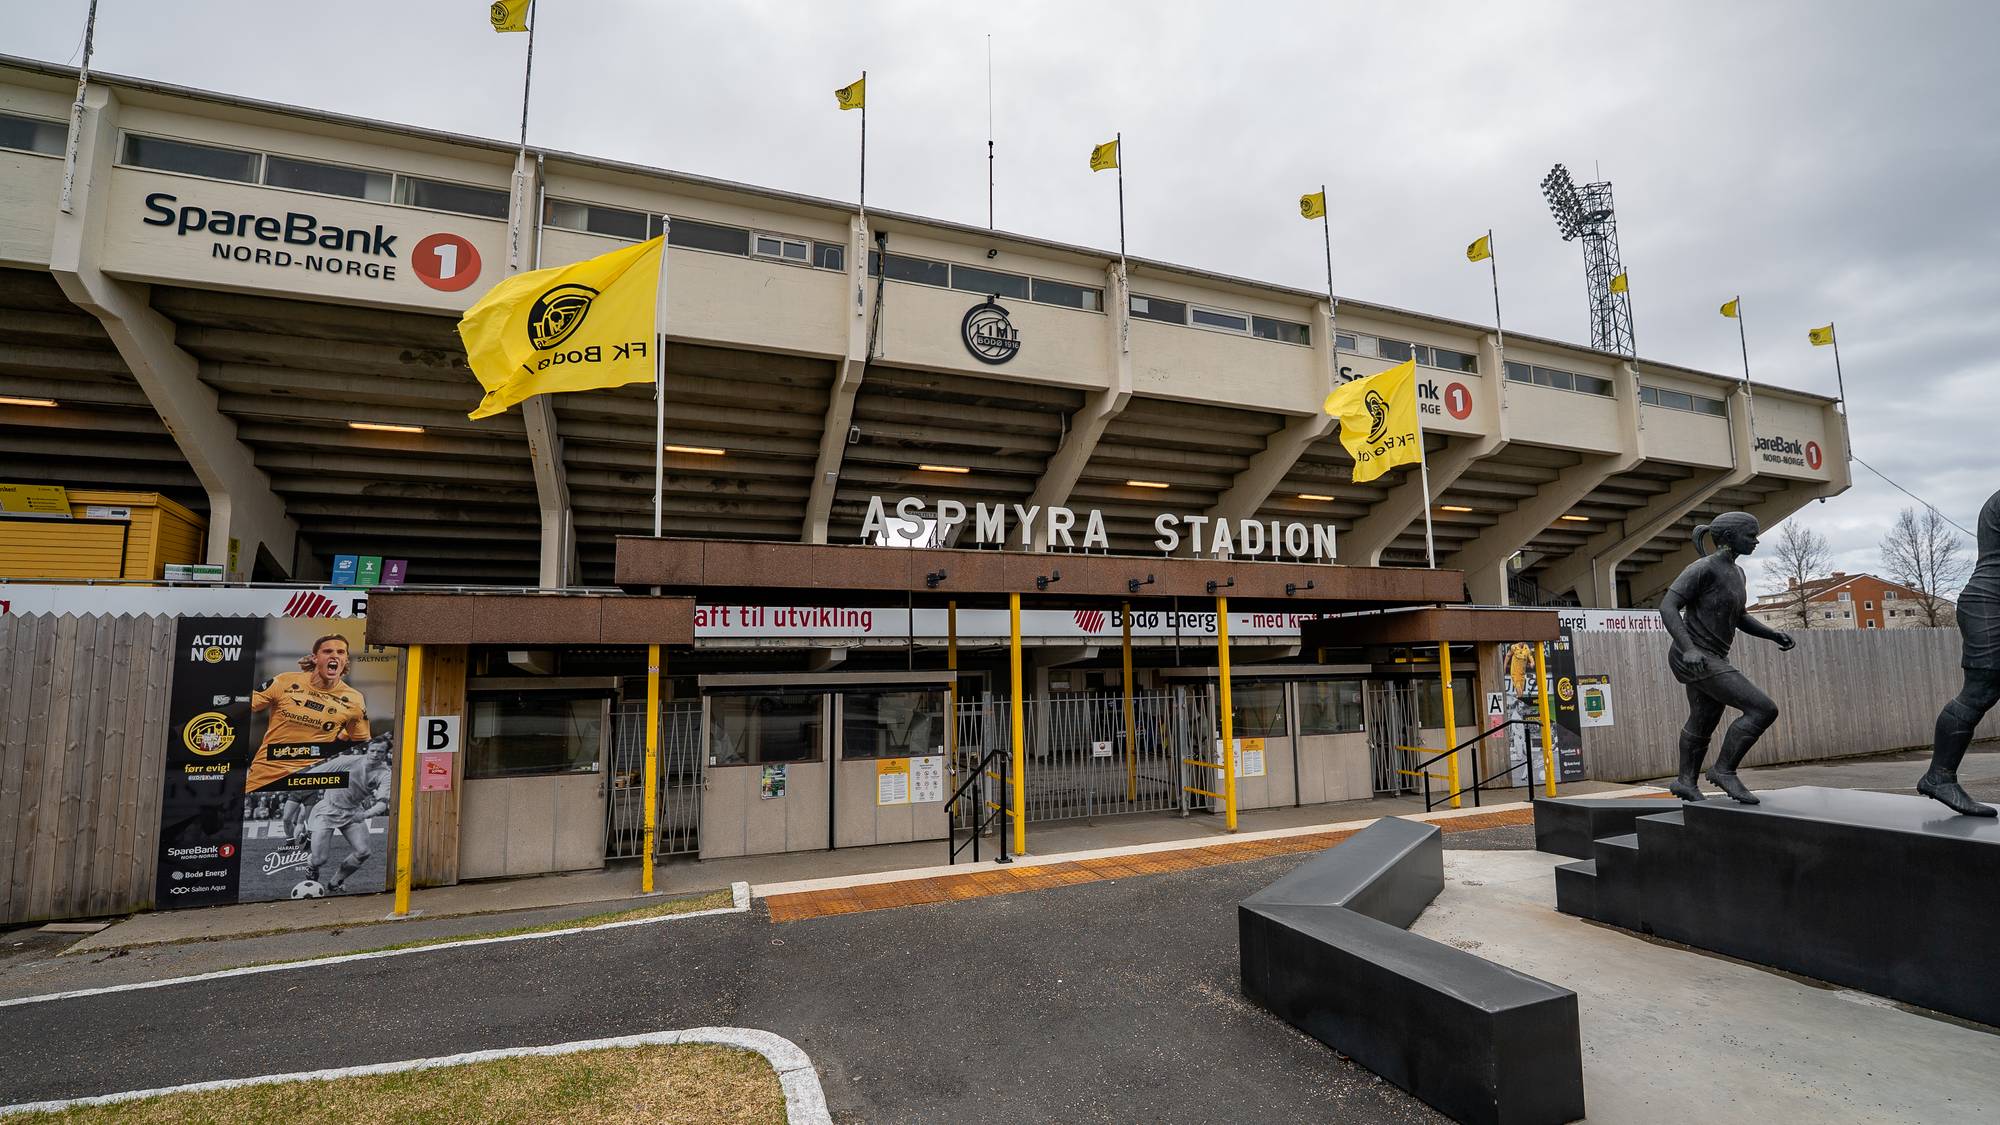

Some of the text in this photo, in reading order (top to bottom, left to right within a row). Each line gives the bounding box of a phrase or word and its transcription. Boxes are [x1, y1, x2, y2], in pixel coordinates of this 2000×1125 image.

[143, 192, 398, 258] SpareBank
[211, 242, 396, 281] NORD-NORGE
[977, 337, 1002, 346] BODØ
[1754, 436, 1803, 455] pareBank
[1762, 453, 1805, 467] NORD-NORGE
[859, 495, 1337, 559] ASPMYRA STADION
[694, 606, 872, 632] aft til utvikling
[1166, 611, 1217, 633] Energ
[1559, 614, 1587, 632] nergi
[1628, 615, 1651, 629] kraft
[192, 634, 243, 646] ACTION
[1490, 694, 1503, 714] A
[426, 718, 450, 750] B
[206, 763, 230, 774] evig!
[287, 776, 341, 786] LEGENDER
[167, 845, 218, 857] SpareBank
[205, 868, 227, 878] Energi
